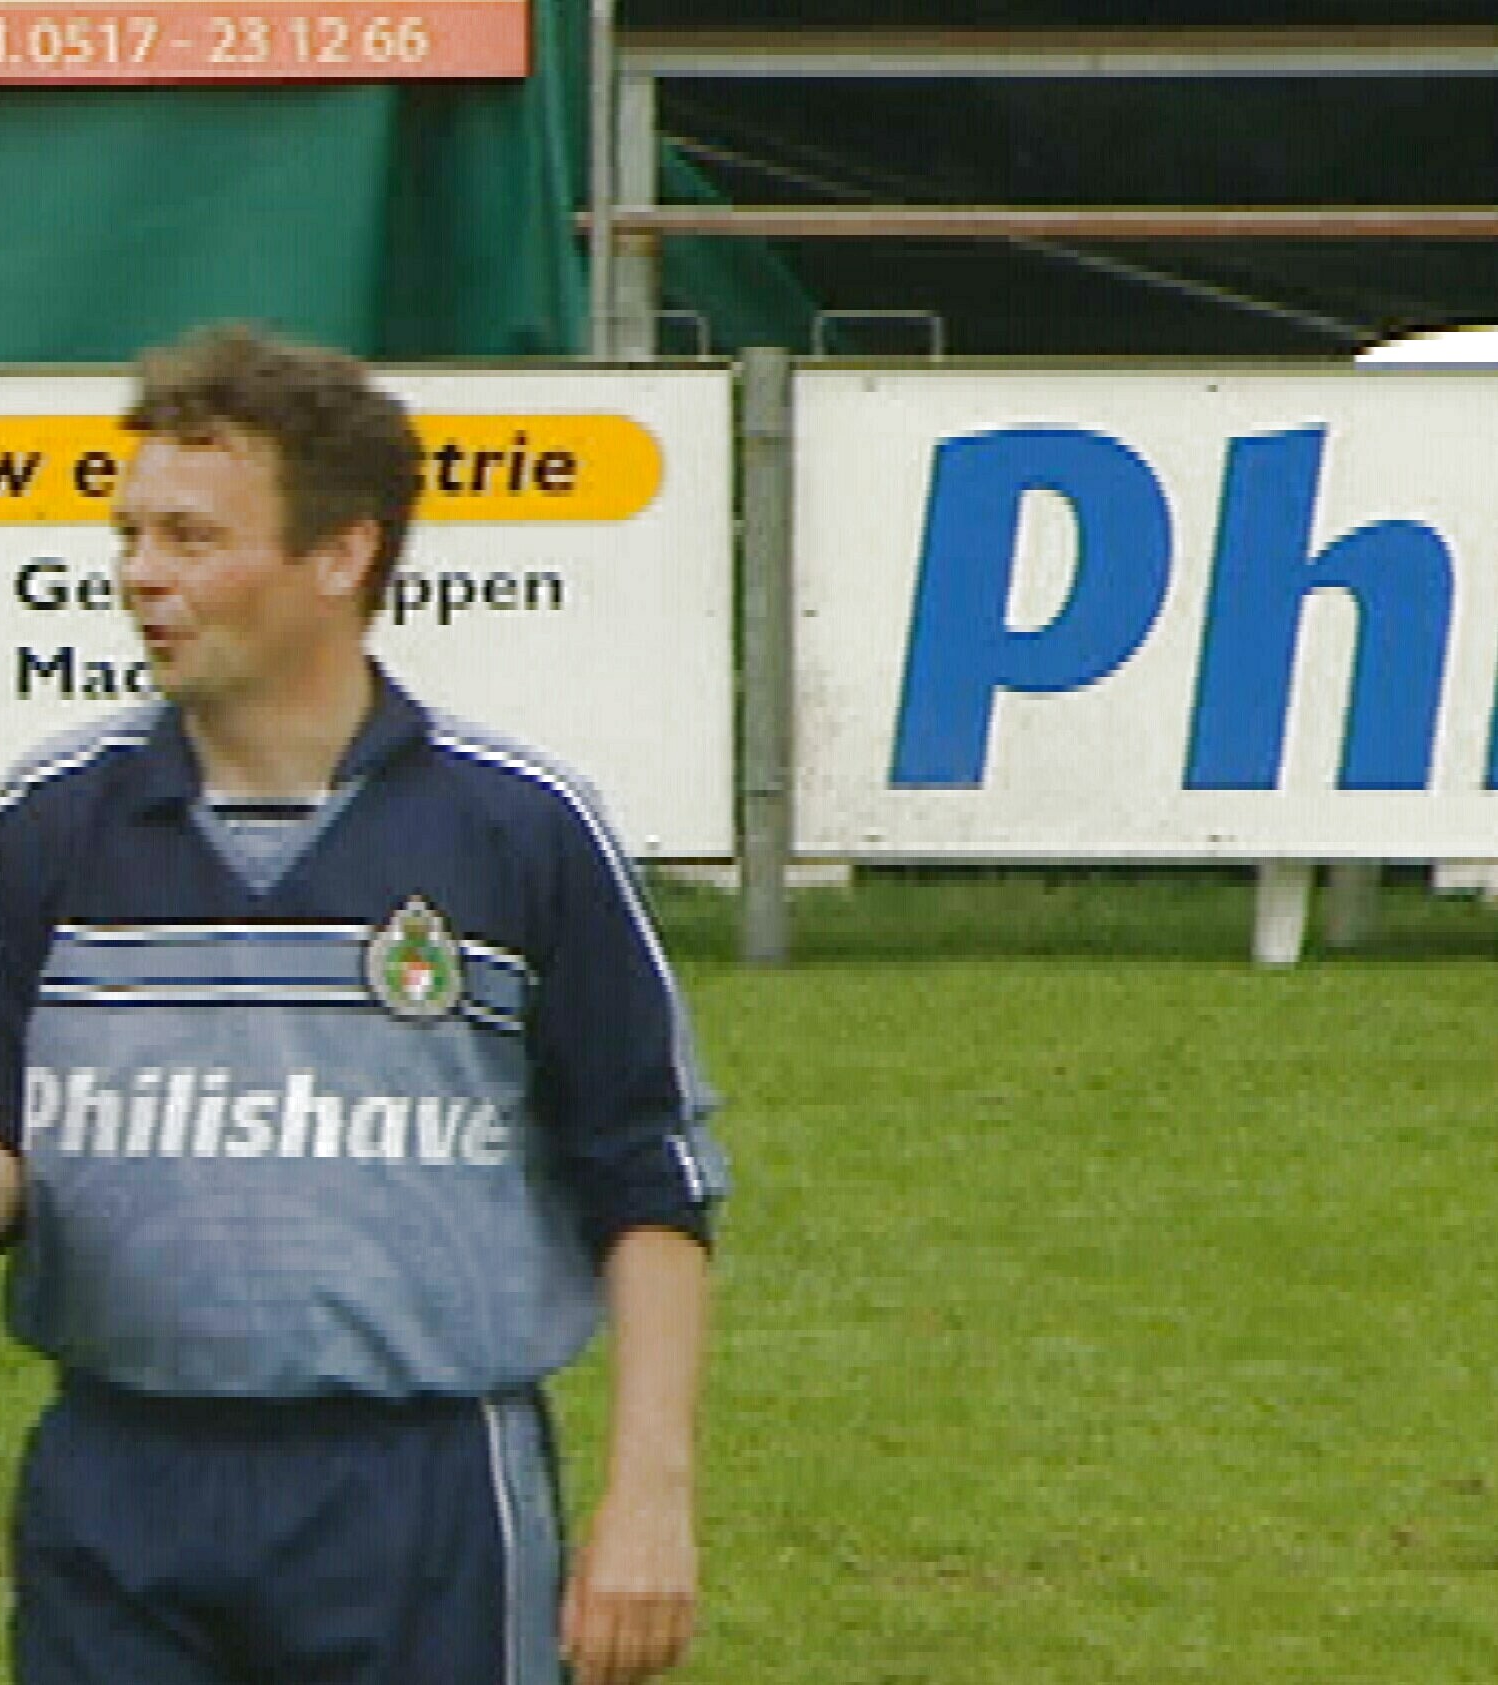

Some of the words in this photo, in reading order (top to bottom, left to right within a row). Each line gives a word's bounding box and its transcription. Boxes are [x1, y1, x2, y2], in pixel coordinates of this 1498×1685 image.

[209, 17, 271, 63] 23
[73, 450, 120, 498] e
[414, 431, 579, 492] trie
[14, 556, 113, 611] Ge
[389, 570, 566, 625] ppen
[889, 423, 1498, 791] Ph
[15, 647, 152, 694] Mac
[22, 1066, 511, 1166] Philishave
